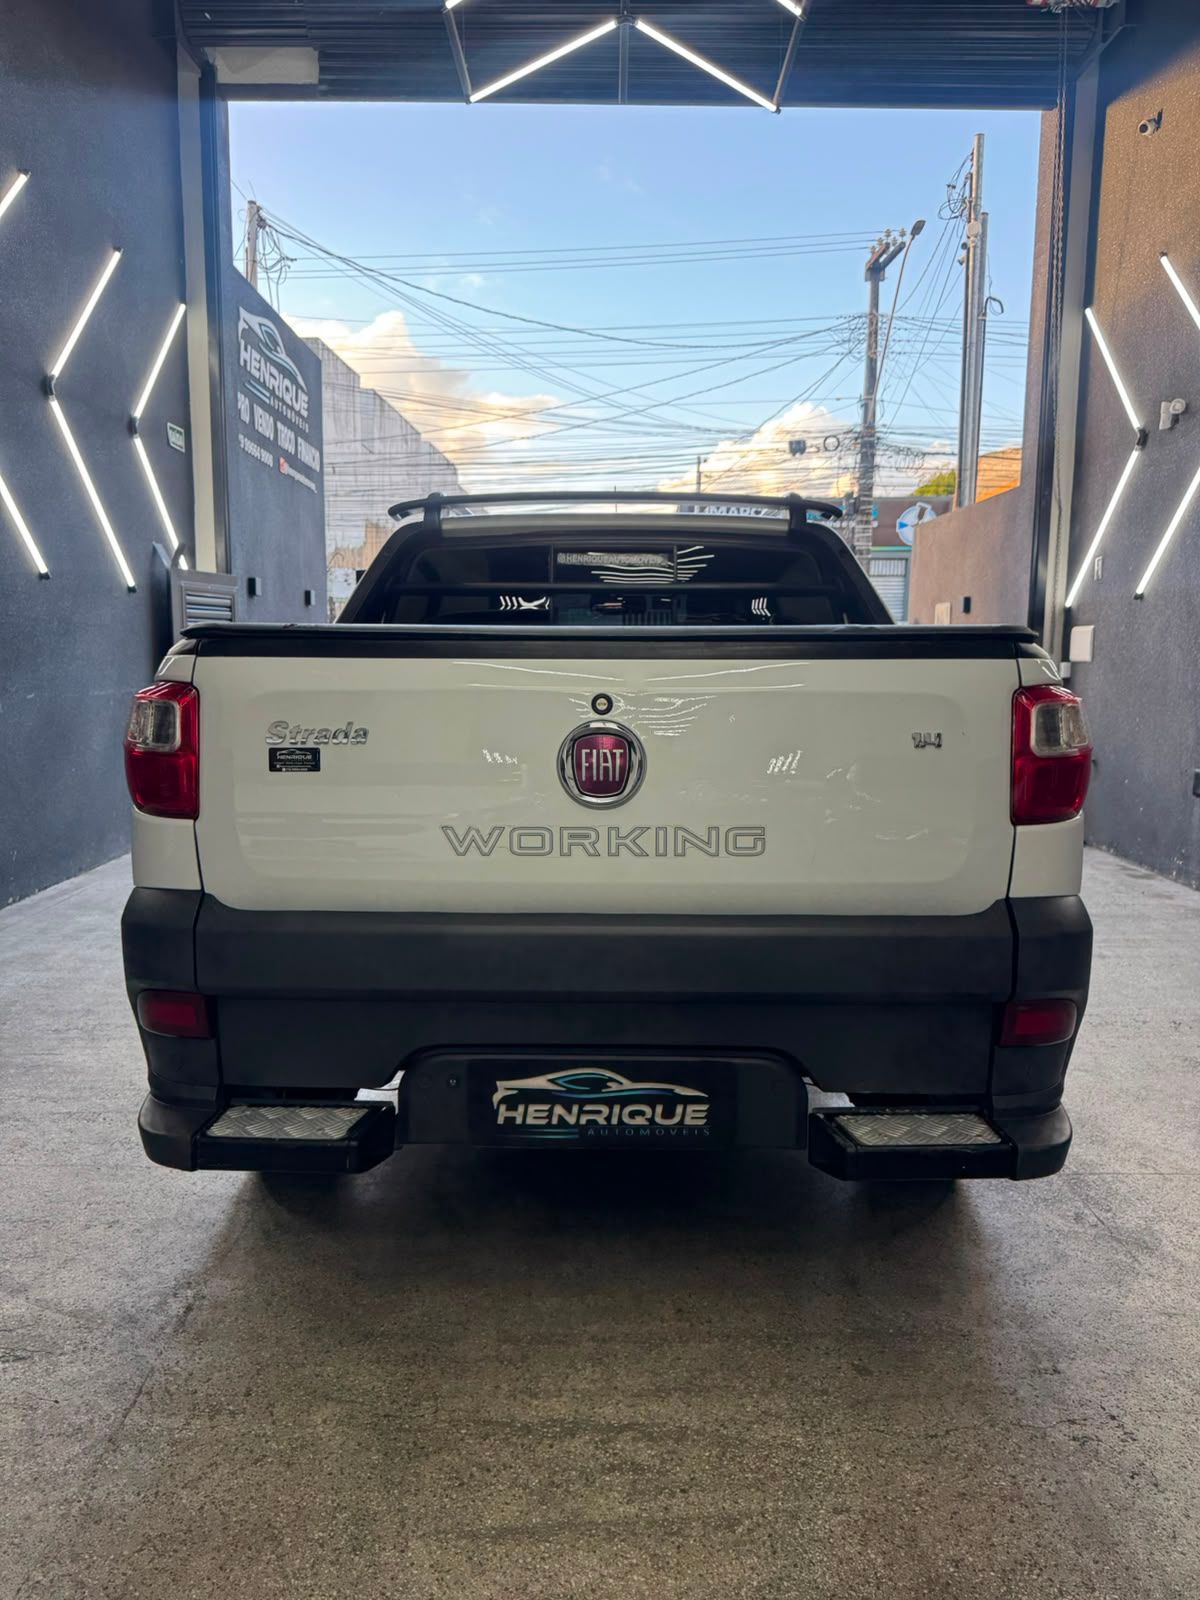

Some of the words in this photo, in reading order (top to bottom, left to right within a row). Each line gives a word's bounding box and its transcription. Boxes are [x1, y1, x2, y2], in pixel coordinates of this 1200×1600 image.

[239, 339, 308, 418] HENRIQUE
[253, 403, 275, 441] VENDO
[276, 420, 296, 455] TROCO
[265, 721, 369, 745] Strada
[581, 748, 624, 784] FIAT
[441, 826, 766, 858] WORKING
[497, 1104, 711, 1125] HENRIQUE
[588, 1127, 711, 1137] AUTOMOVEIS
